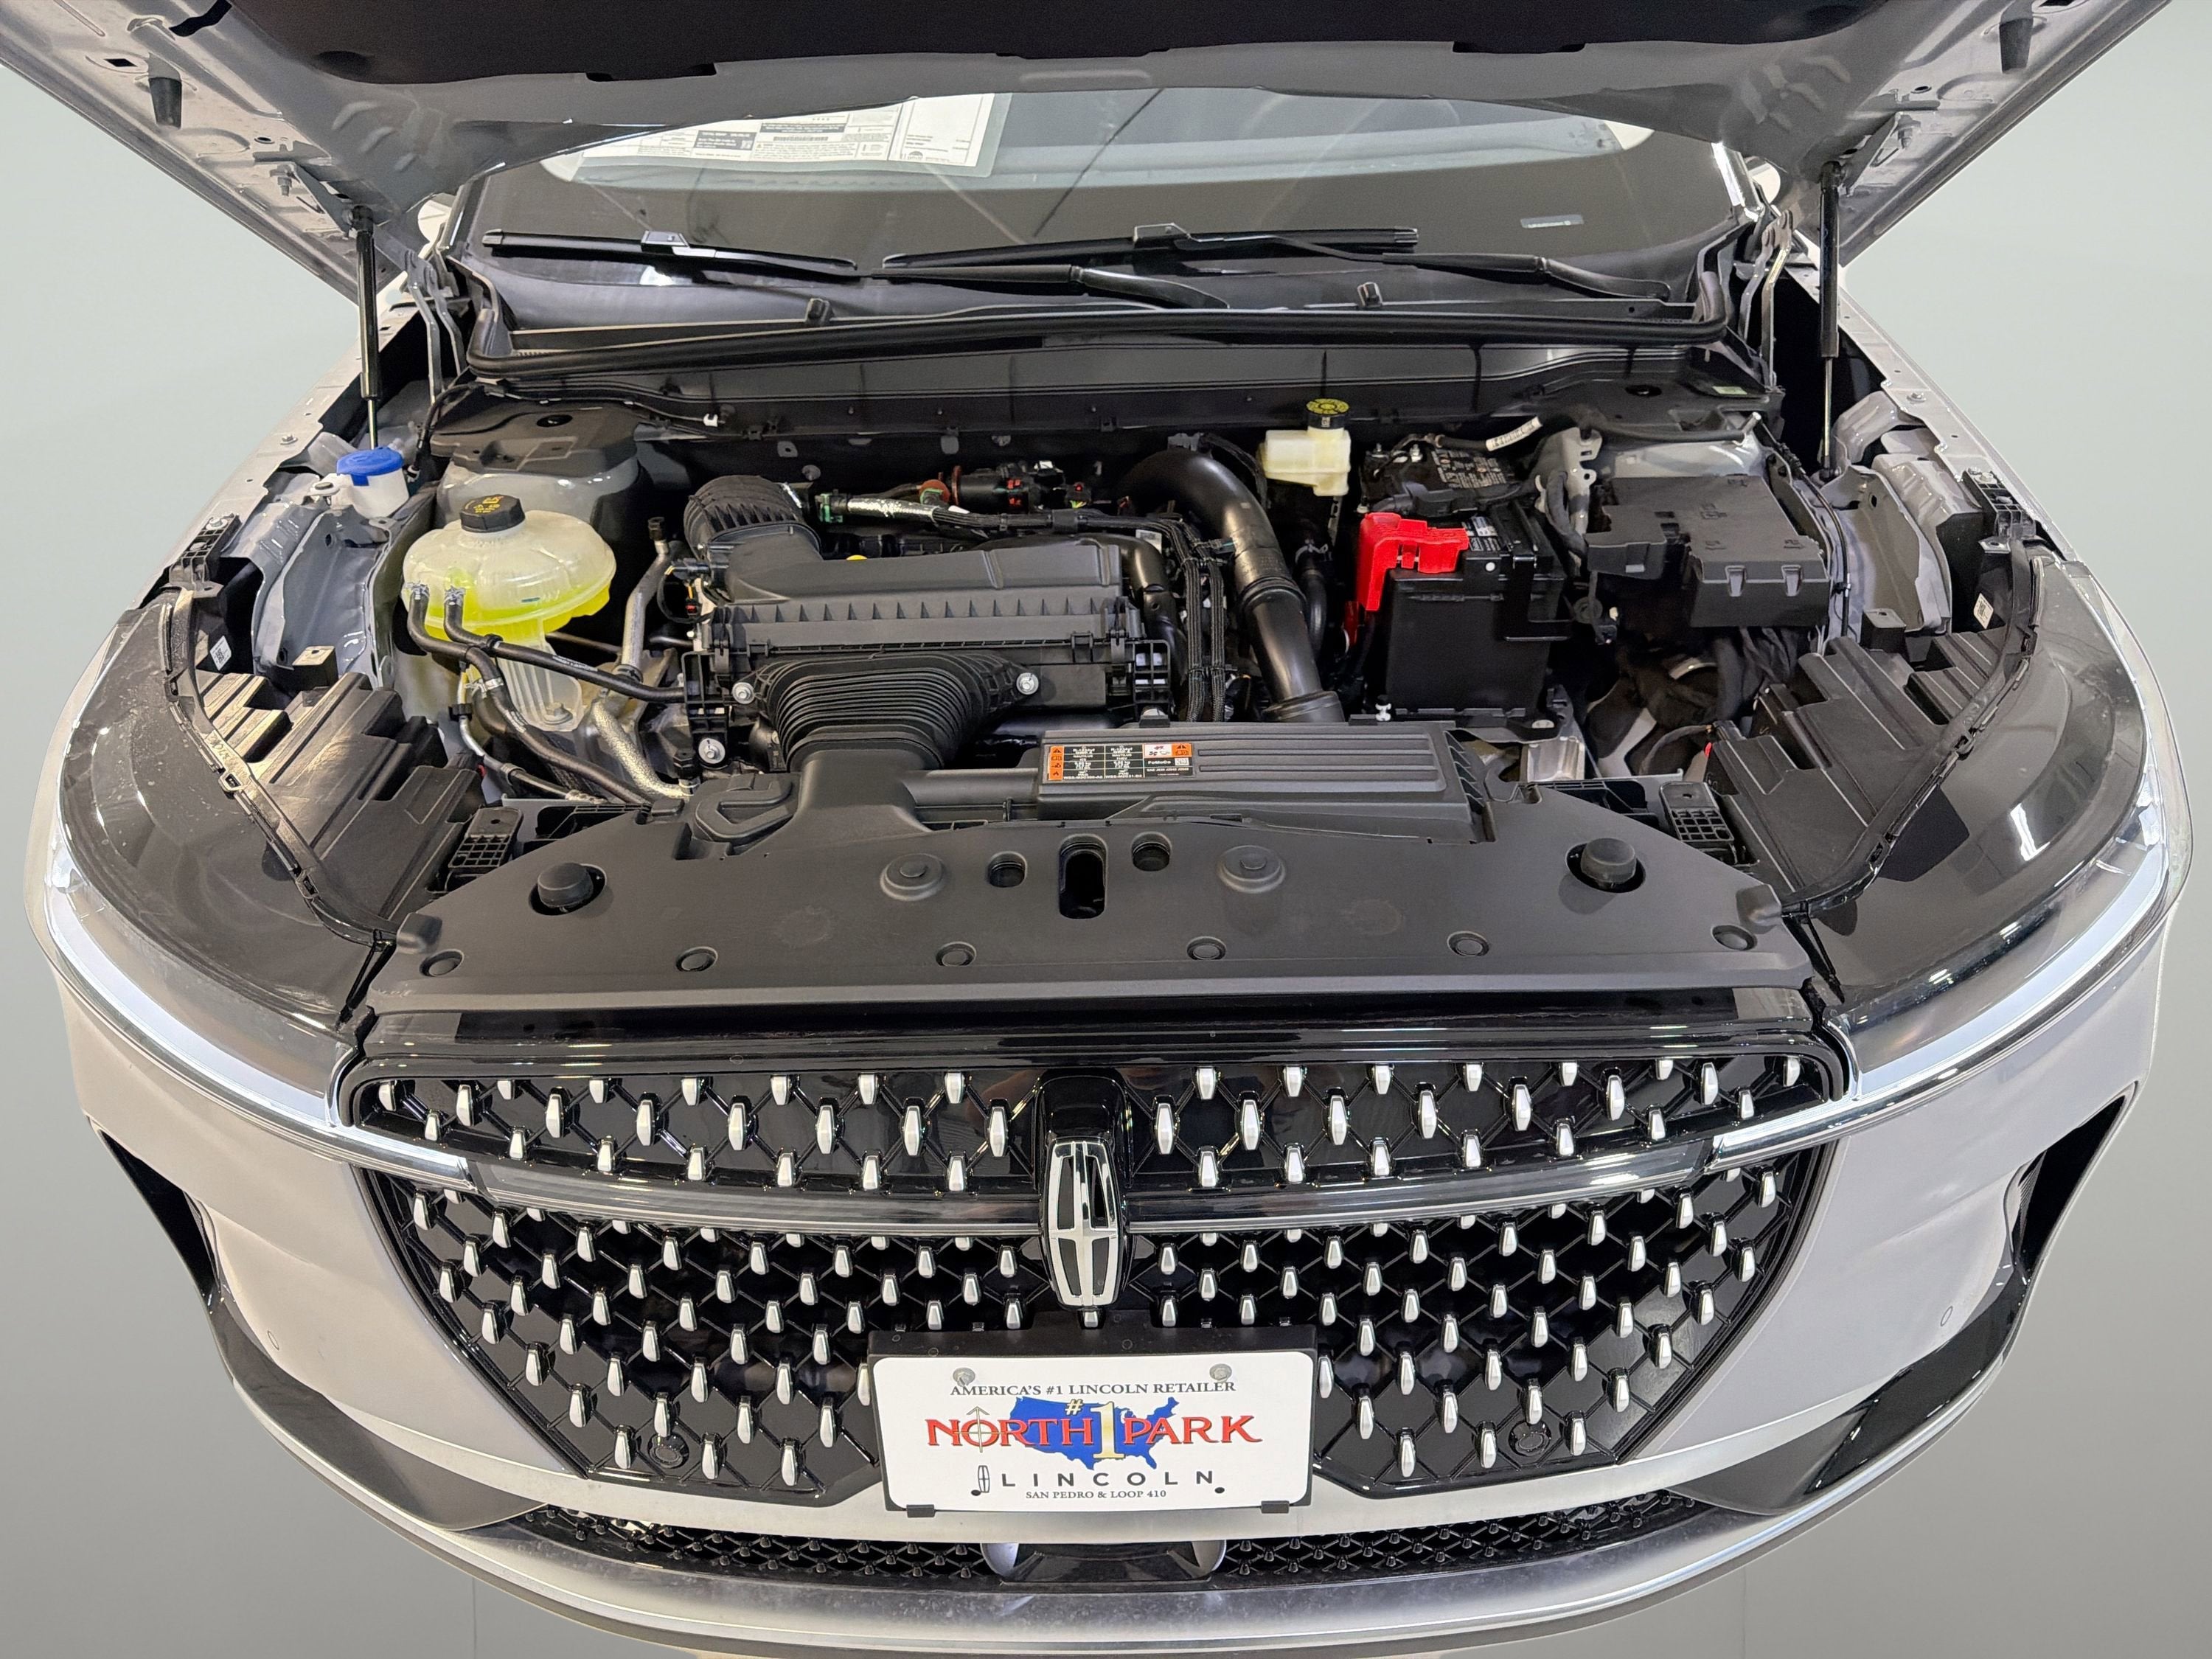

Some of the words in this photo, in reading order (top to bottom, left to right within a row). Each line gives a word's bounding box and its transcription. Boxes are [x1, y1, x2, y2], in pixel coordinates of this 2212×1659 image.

[950, 1385, 1041, 1396] AMERICA'S
[1046, 1385, 1063, 1395] #1
[1068, 1383, 1148, 1395] LINCOLN
[1153, 1382, 1236, 1394] RETAILER
[925, 1418, 1094, 1447] NORTH
[1123, 1415, 1263, 1444] PARK
[1001, 1470, 1213, 1486] LINCOLN
[1026, 1491, 1050, 1499] SAN
[1052, 1491, 1094, 1499] PEDRO
[1147, 1489, 1166, 1498] 410
